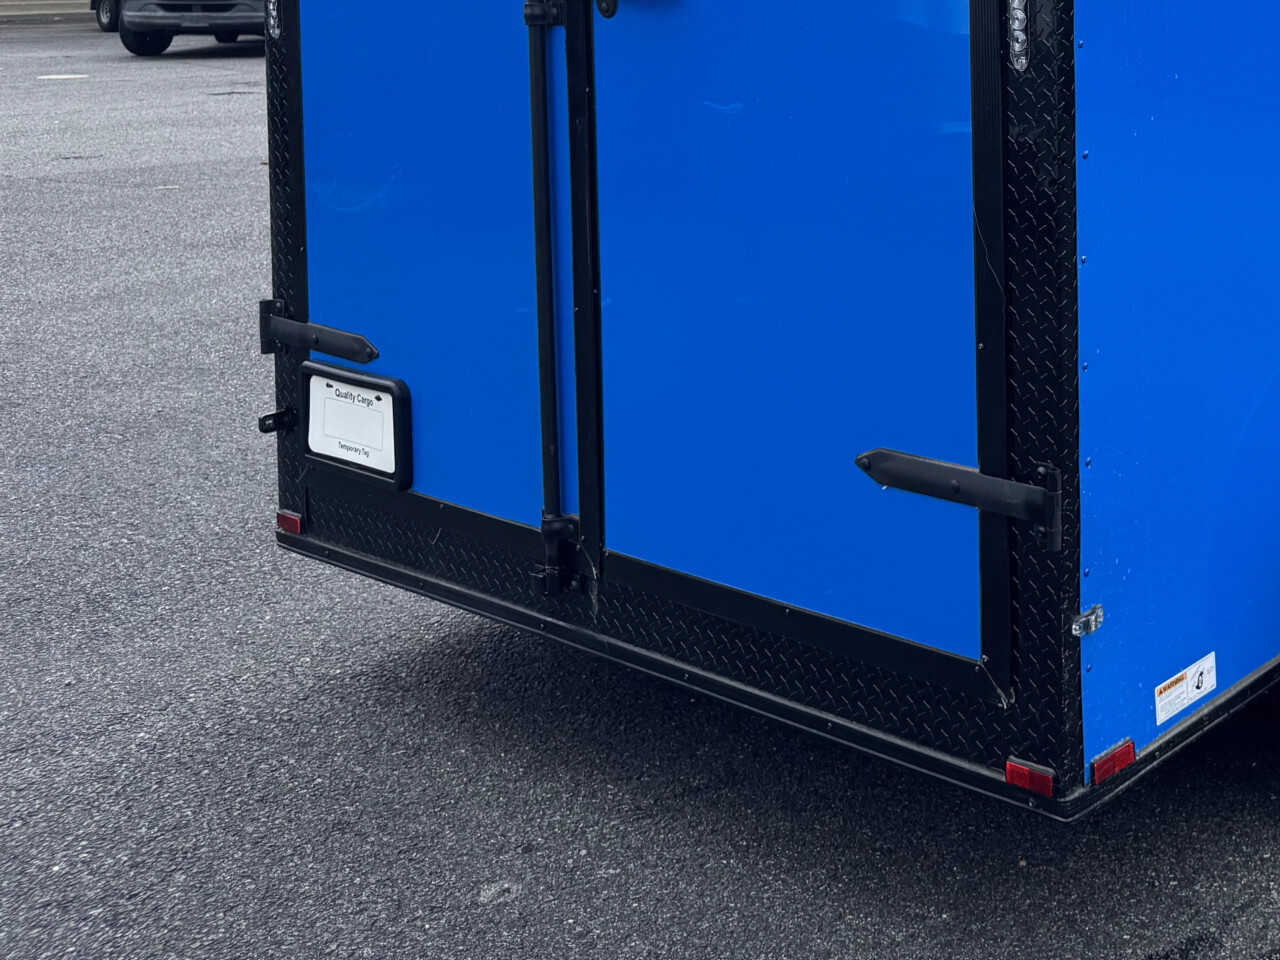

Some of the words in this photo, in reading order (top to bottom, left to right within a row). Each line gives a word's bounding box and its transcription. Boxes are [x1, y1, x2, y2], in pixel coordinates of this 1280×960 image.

[335, 388, 356, 404] Quality
[356, 393, 374, 407] Cargo
[338, 441, 361, 455] Temporary
[361, 448, 370, 458] Tag
